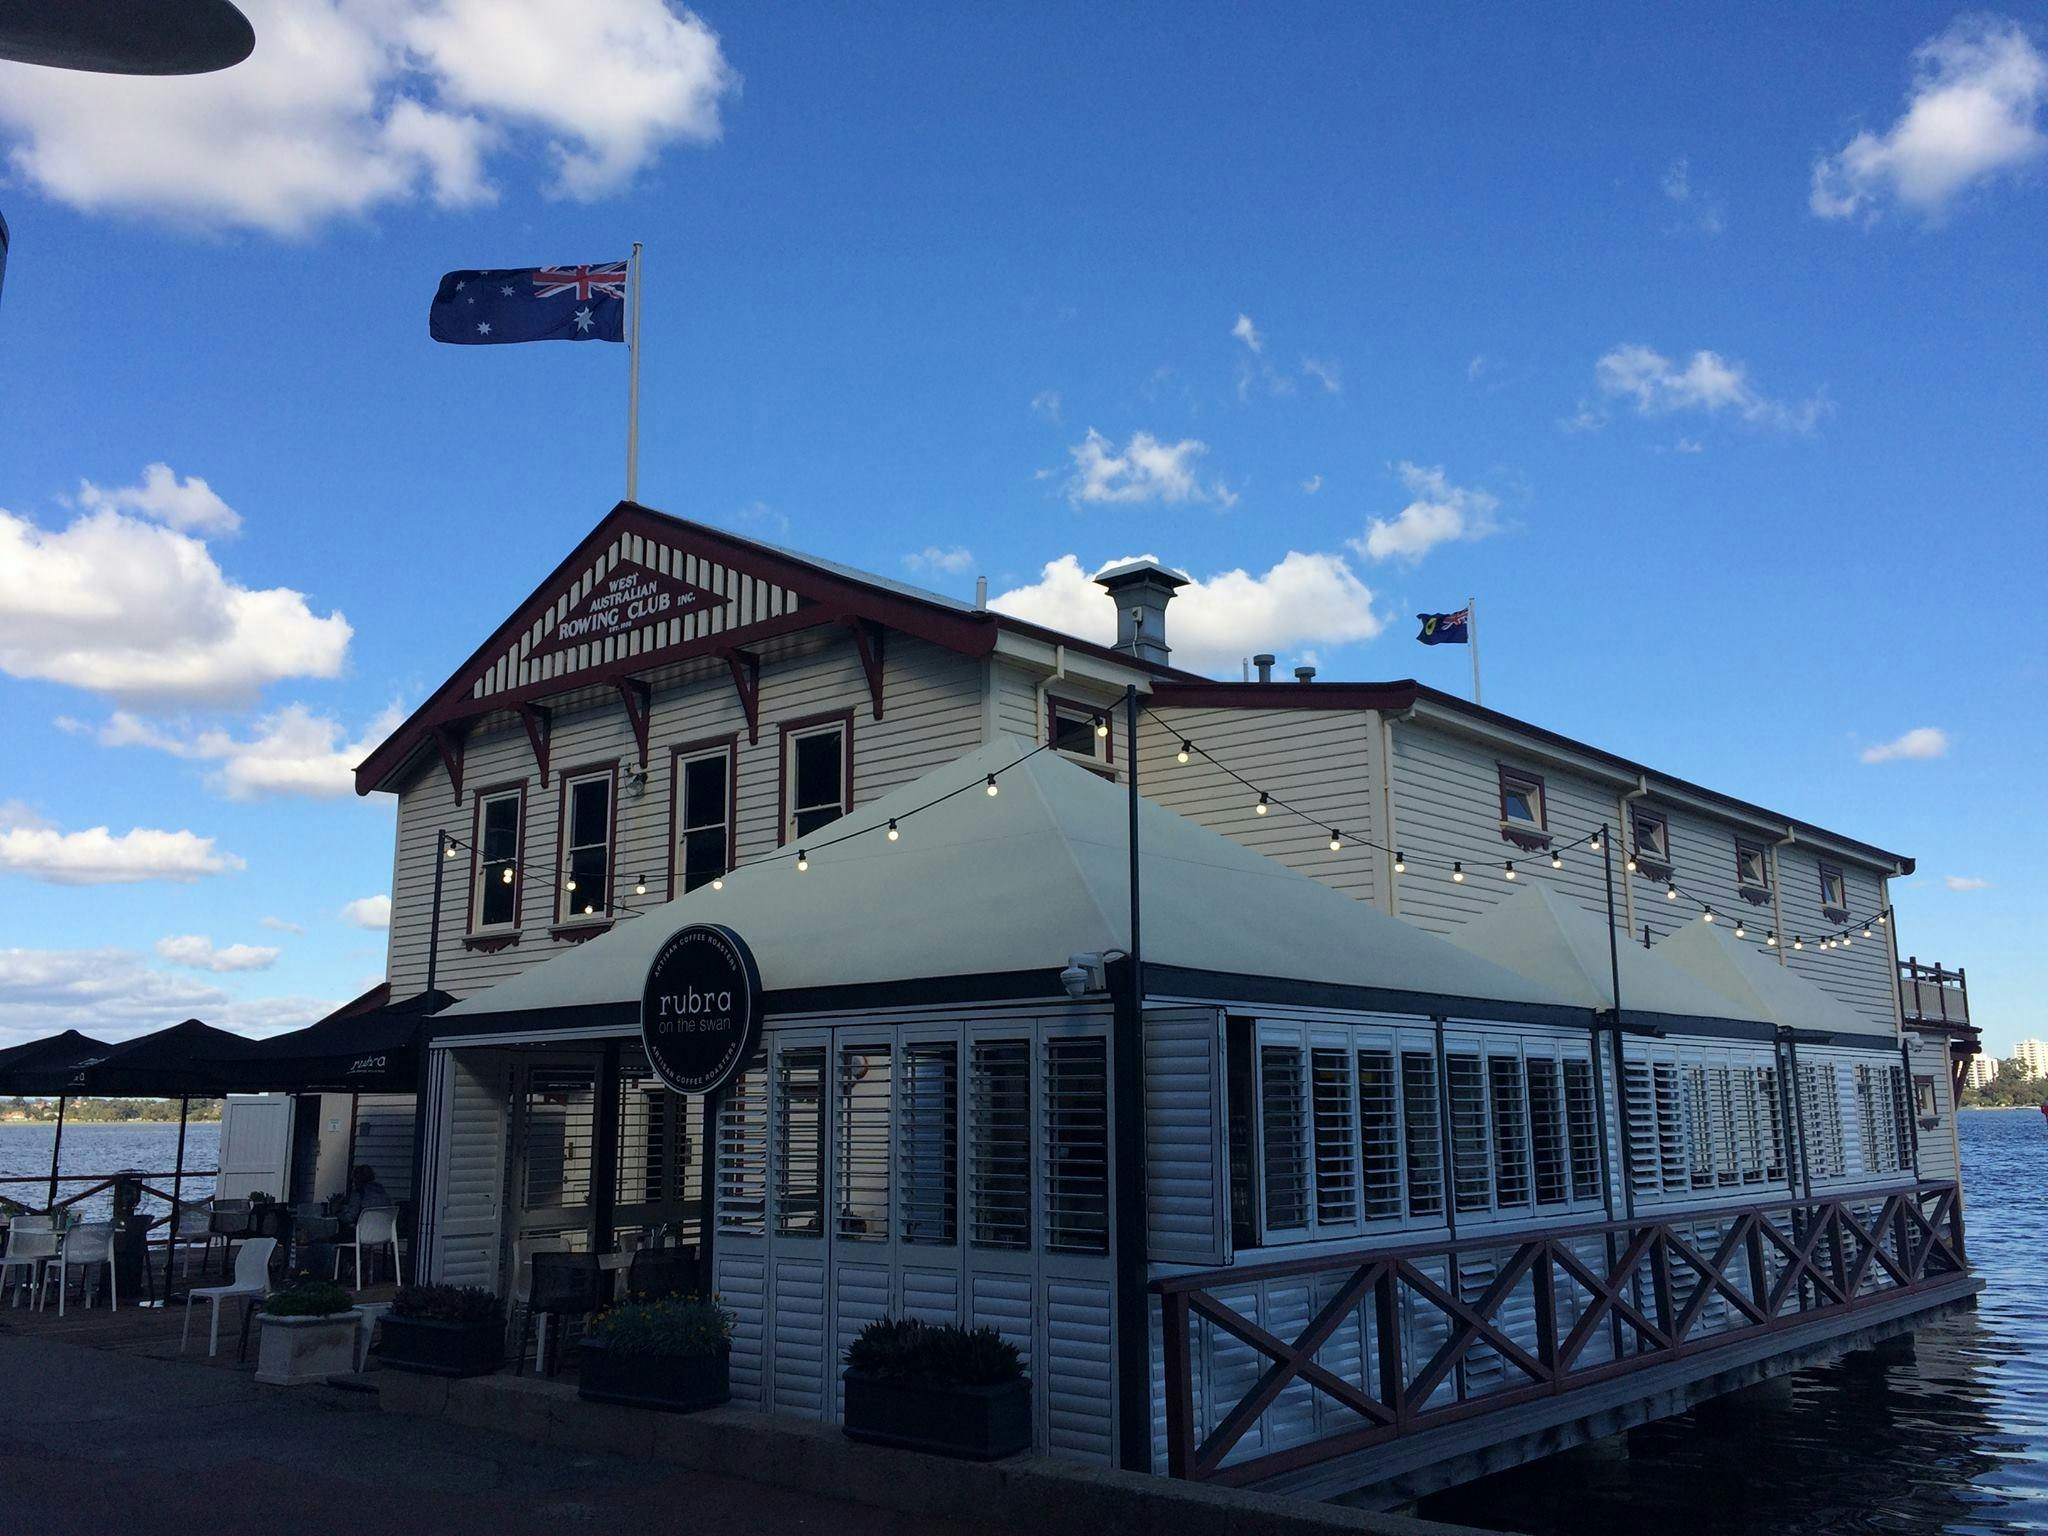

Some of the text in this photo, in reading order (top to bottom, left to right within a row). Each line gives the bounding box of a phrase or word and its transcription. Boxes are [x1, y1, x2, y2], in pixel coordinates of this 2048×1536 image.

[589, 581, 657, 613] AUSTRALIAN
[609, 572, 639, 592] WEST
[559, 592, 696, 640] ROWING CLUB INC.
[655, 933, 737, 977] ARTISAN COFFEE ROASTERS
[659, 985, 731, 1016] rubra
[659, 1017, 731, 1034] on the swan
[652, 1042, 736, 1085] ARTISAN COFFEE ROASTERS
